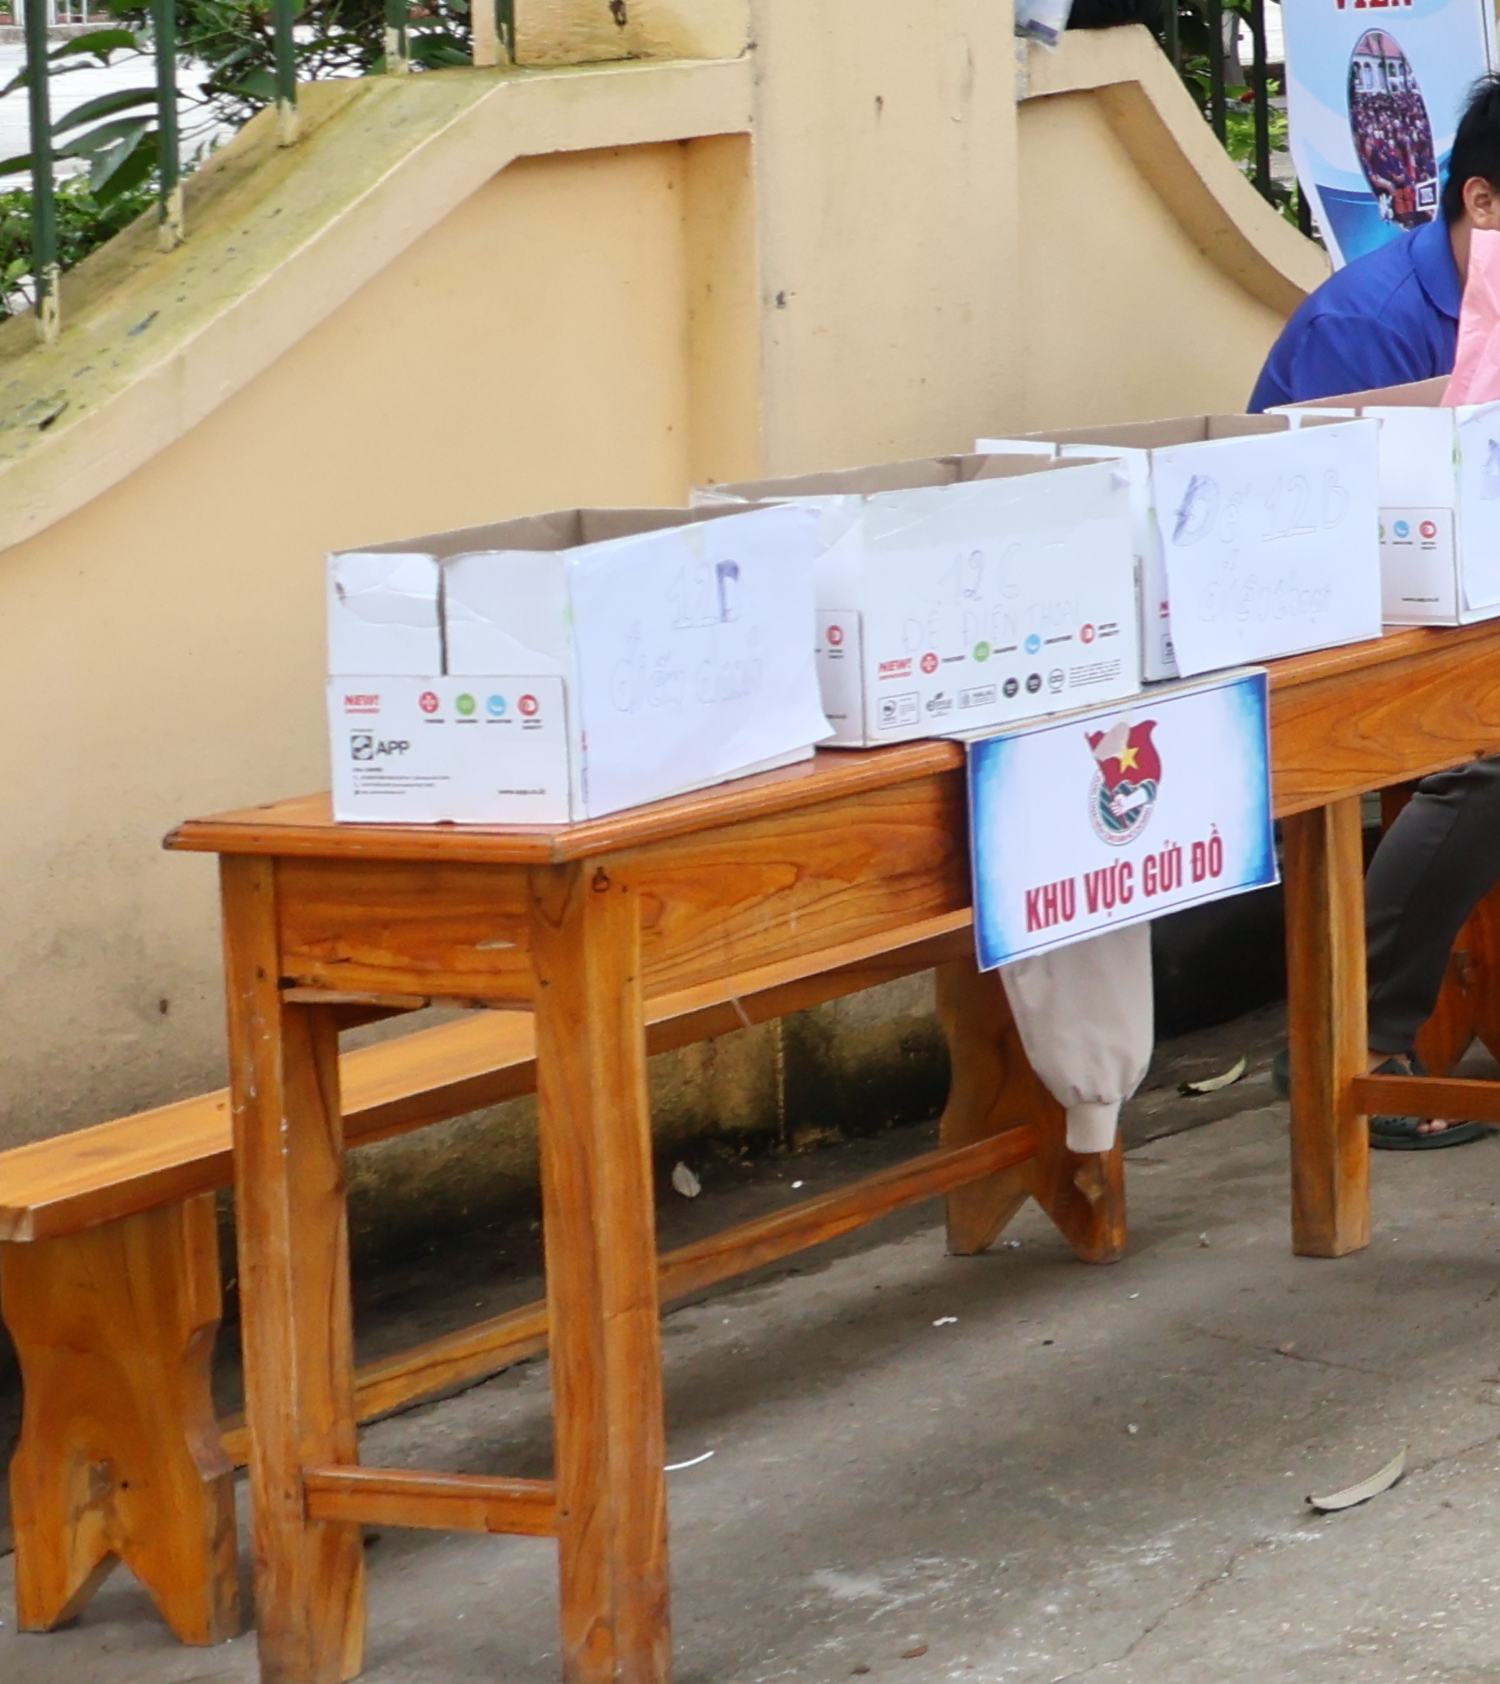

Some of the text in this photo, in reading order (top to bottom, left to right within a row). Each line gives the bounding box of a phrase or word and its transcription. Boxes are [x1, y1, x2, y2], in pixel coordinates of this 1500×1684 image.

[376, 740, 410, 756] APP
[1025, 822, 1223, 933] KHU VỰC GỬI ĐỒ
